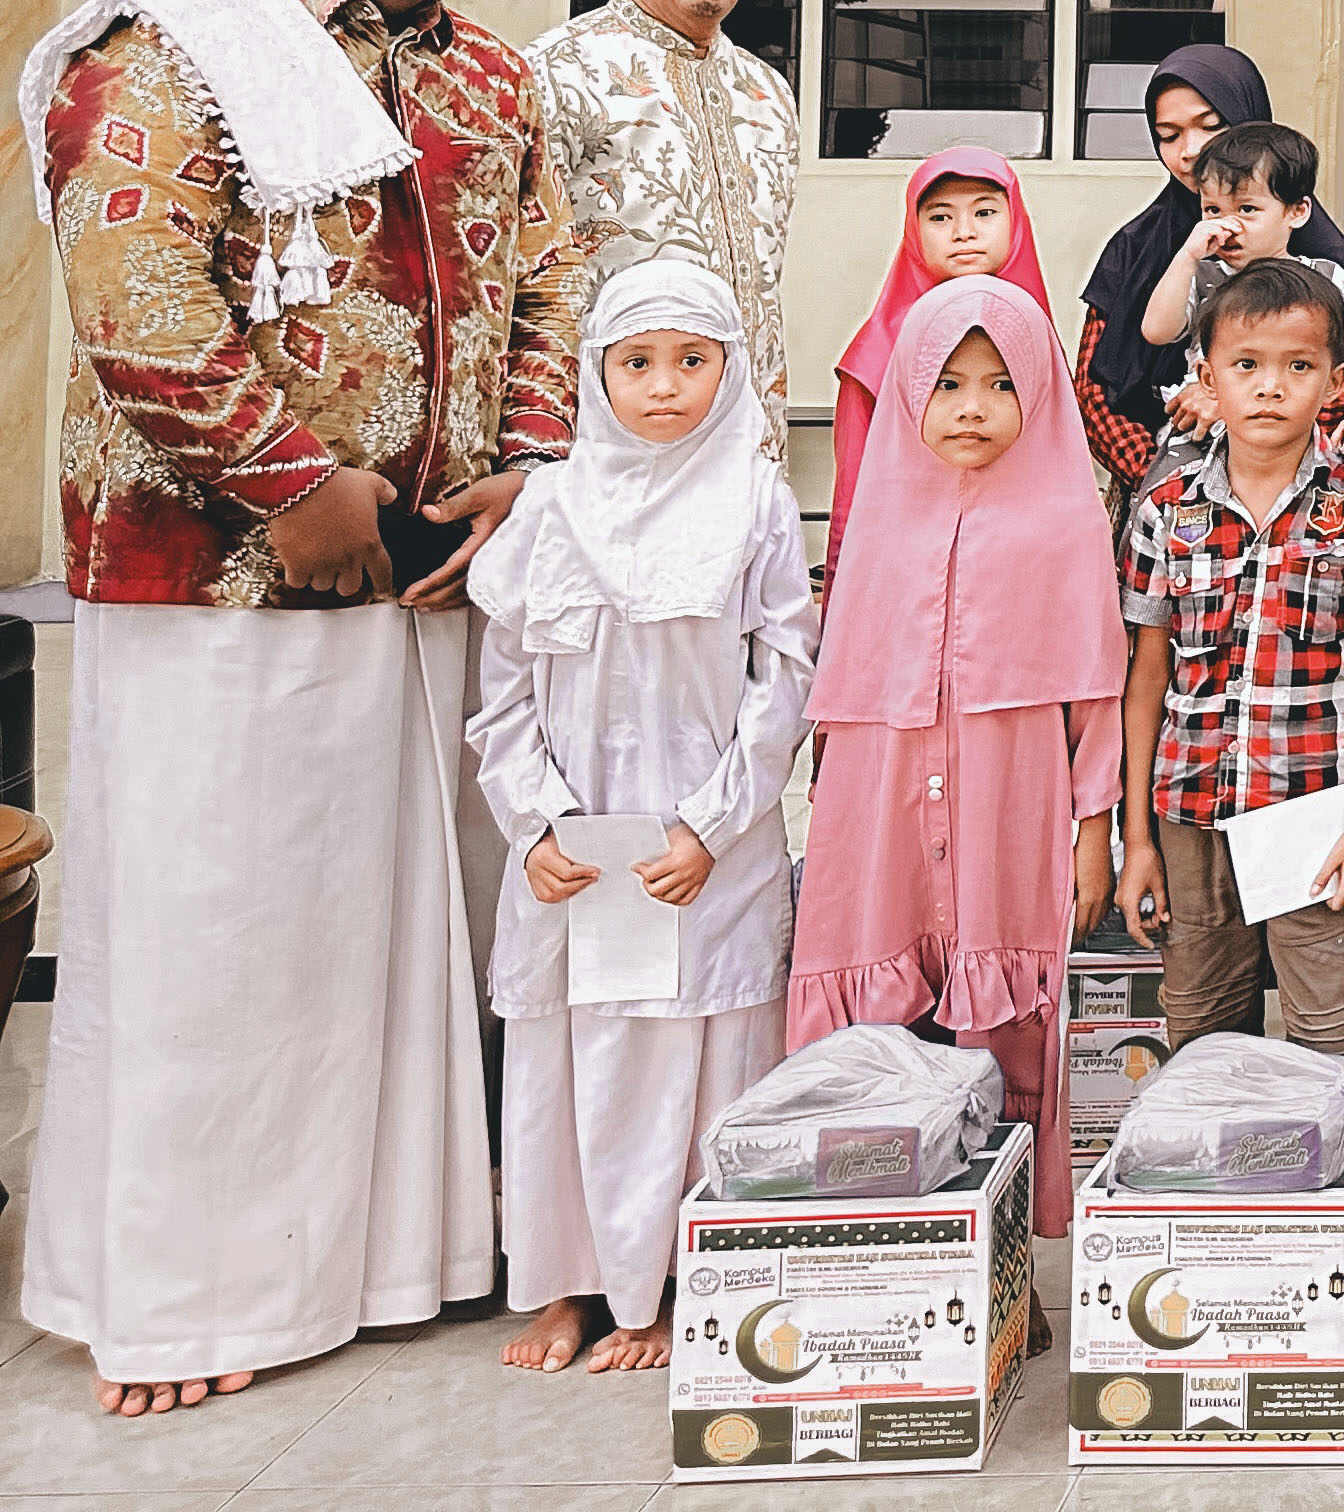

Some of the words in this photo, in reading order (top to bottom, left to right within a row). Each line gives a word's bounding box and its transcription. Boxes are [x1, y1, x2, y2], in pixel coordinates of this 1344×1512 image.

[1179, 515, 1208, 527] SINCE
[1115, 1234, 1162, 1246] Kampus
[1115, 1242, 1165, 1253] Merdeka
[723, 1266, 773, 1280] Kampus
[724, 1273, 776, 1286] Merdeka
[1190, 1308, 1242, 1321] Ibadah
[1245, 1308, 1290, 1321] Puasa
[801, 1338, 856, 1353] Ibadah
[859, 1336, 906, 1351] Puasa
[1189, 1398, 1241, 1408] BERBAGI
[799, 1428, 854, 1441] BERBAGI
